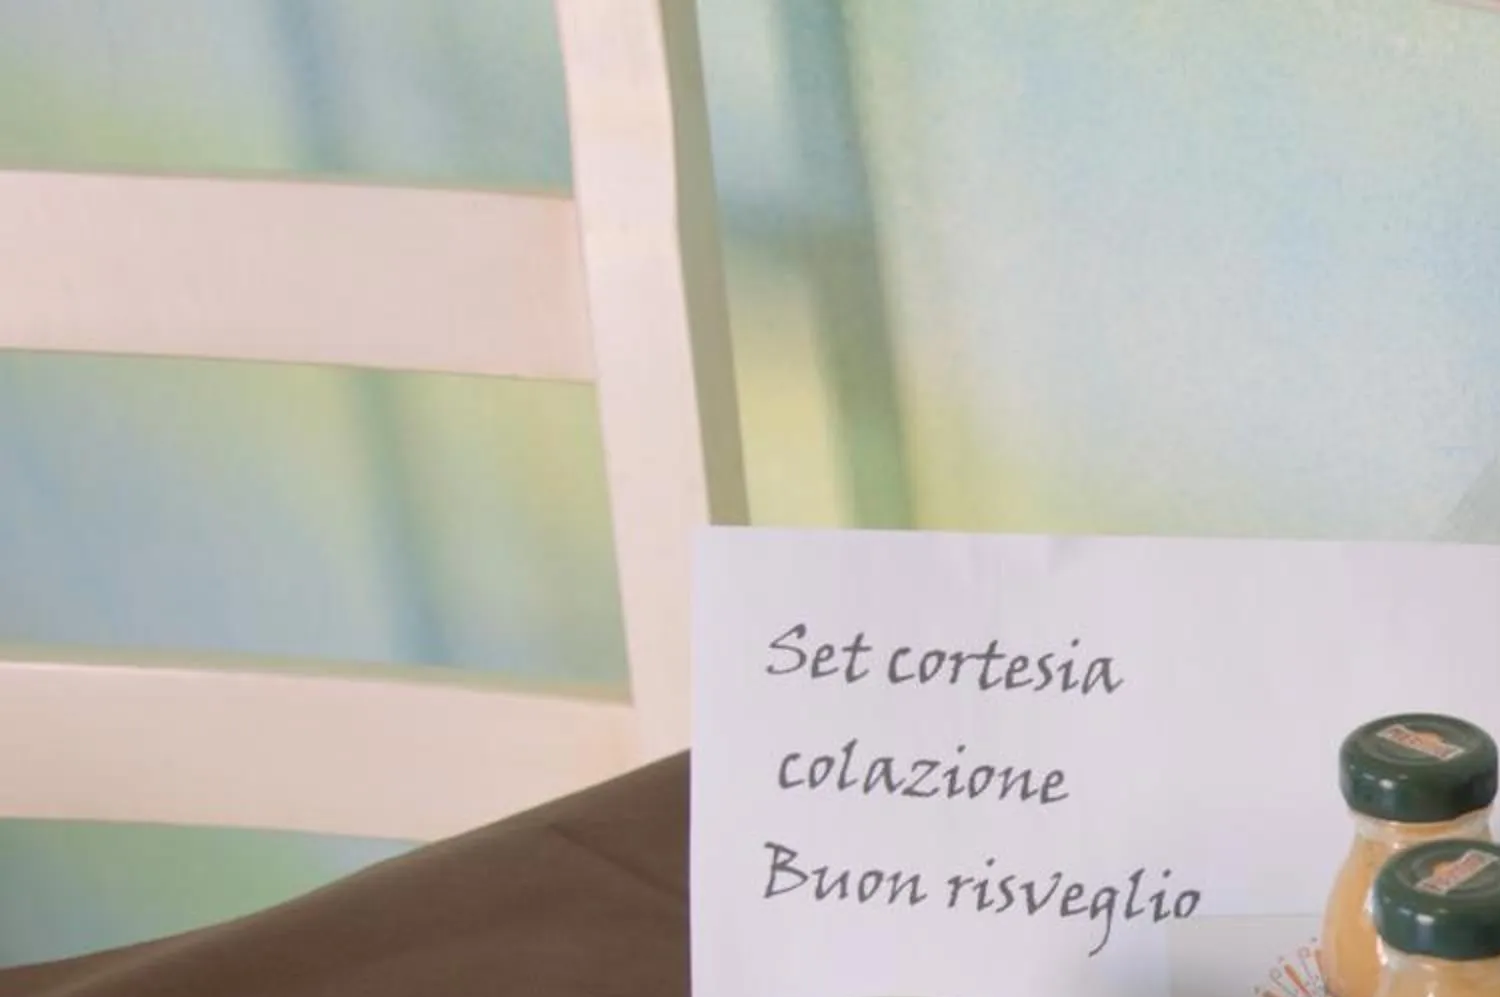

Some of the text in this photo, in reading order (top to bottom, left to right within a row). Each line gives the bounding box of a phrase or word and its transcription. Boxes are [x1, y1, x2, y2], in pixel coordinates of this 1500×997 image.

[764, 622, 1125, 696] Set cortesia
[777, 737, 1070, 806] colazione
[762, 840, 1202, 958] Buon risveglio
